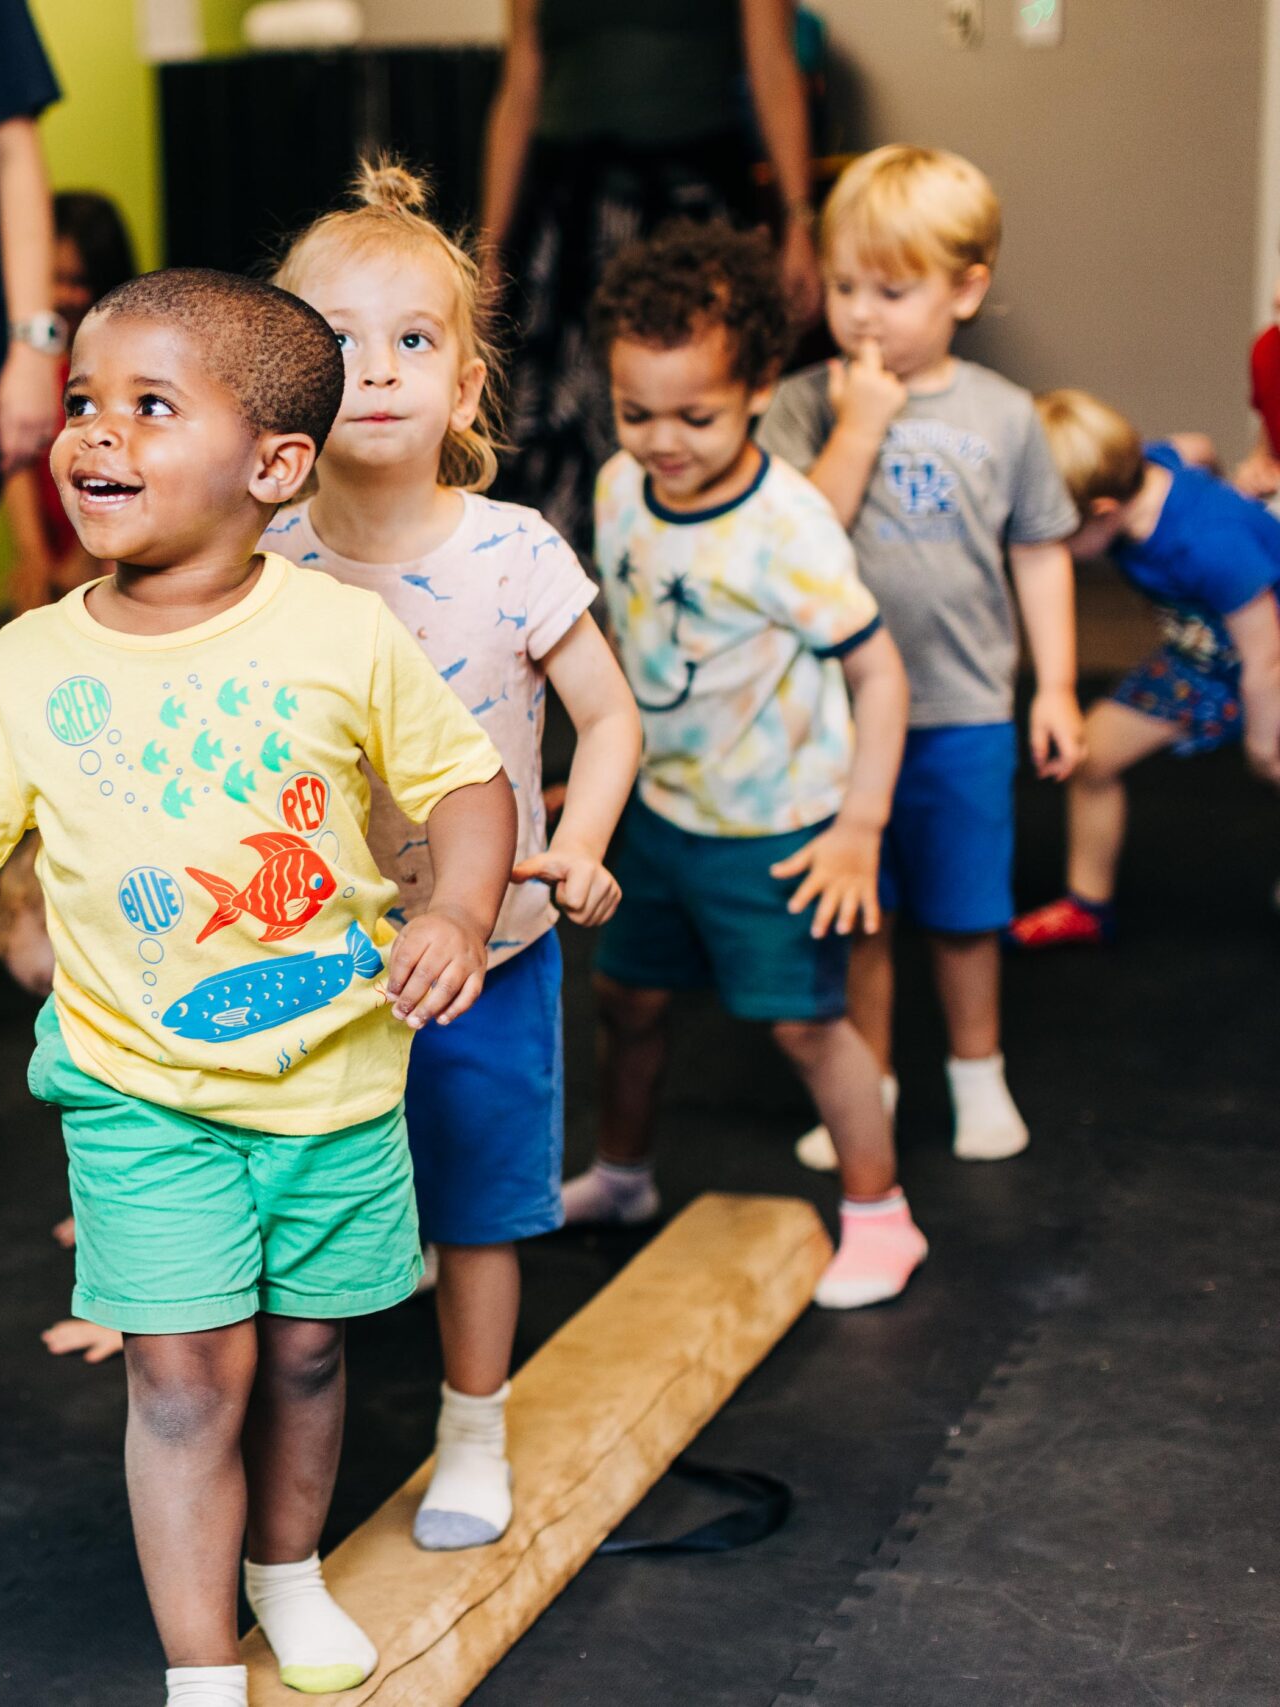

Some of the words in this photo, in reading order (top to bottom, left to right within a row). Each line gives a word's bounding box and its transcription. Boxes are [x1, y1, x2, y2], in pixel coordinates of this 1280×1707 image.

[49, 680, 109, 743] GREEN
[282, 776, 326, 832] RED
[121, 871, 180, 932] BLUE
